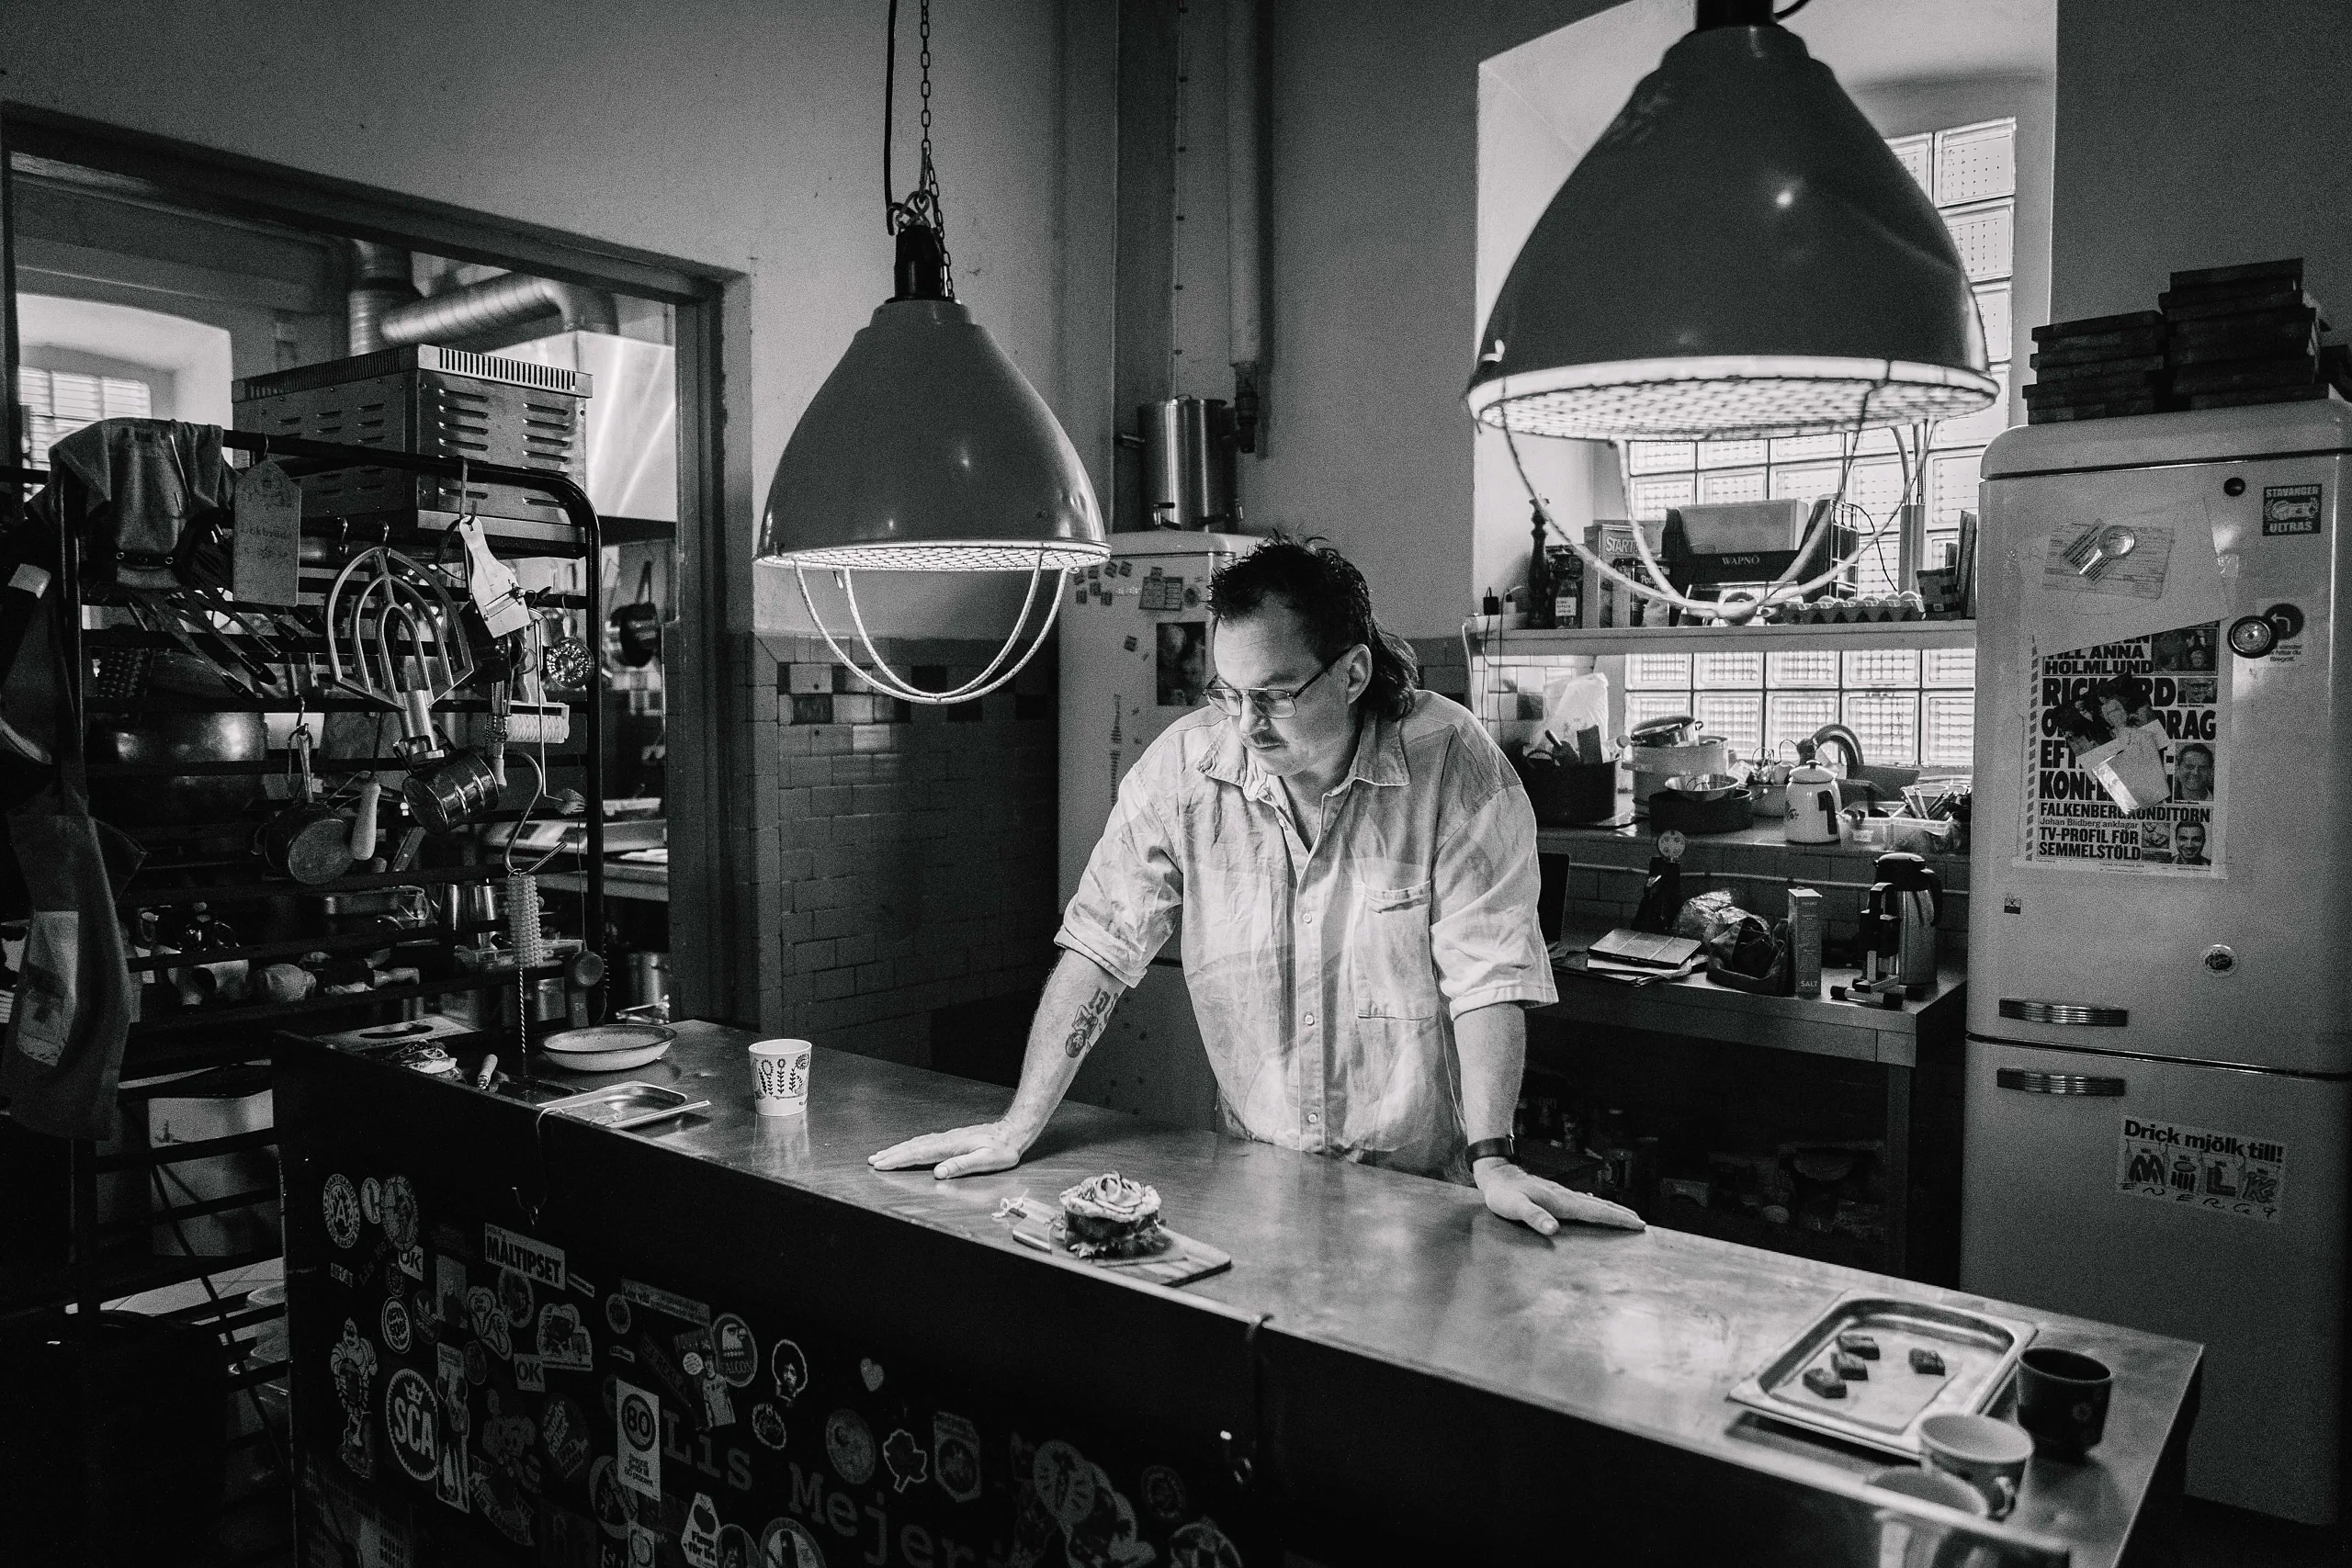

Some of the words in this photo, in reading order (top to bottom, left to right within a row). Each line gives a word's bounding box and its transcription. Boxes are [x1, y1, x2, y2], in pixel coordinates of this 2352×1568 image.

[2269, 521, 2312, 534] ULTRAS
[1721, 554, 1759, 566] WAPNÖ
[2089, 645, 2145, 660] ANNA
[2043, 660, 2154, 675] HOLMLUND
[2040, 818, 2064, 826] Johan
[2102, 819, 2138, 829] anklagar
[2040, 826, 2108, 842] TV-PROFIL
[2111, 829, 2139, 844] FÖR
[2039, 840, 2142, 860] SEMMELSTÖLD
[2124, 1119, 2180, 1145] Drick
[2185, 1134, 2245, 1157] mjölk
[486, 1235, 561, 1284] MÅLTIPSET
[516, 1361, 544, 1384] OK
[626, 1404, 651, 1438] 80
